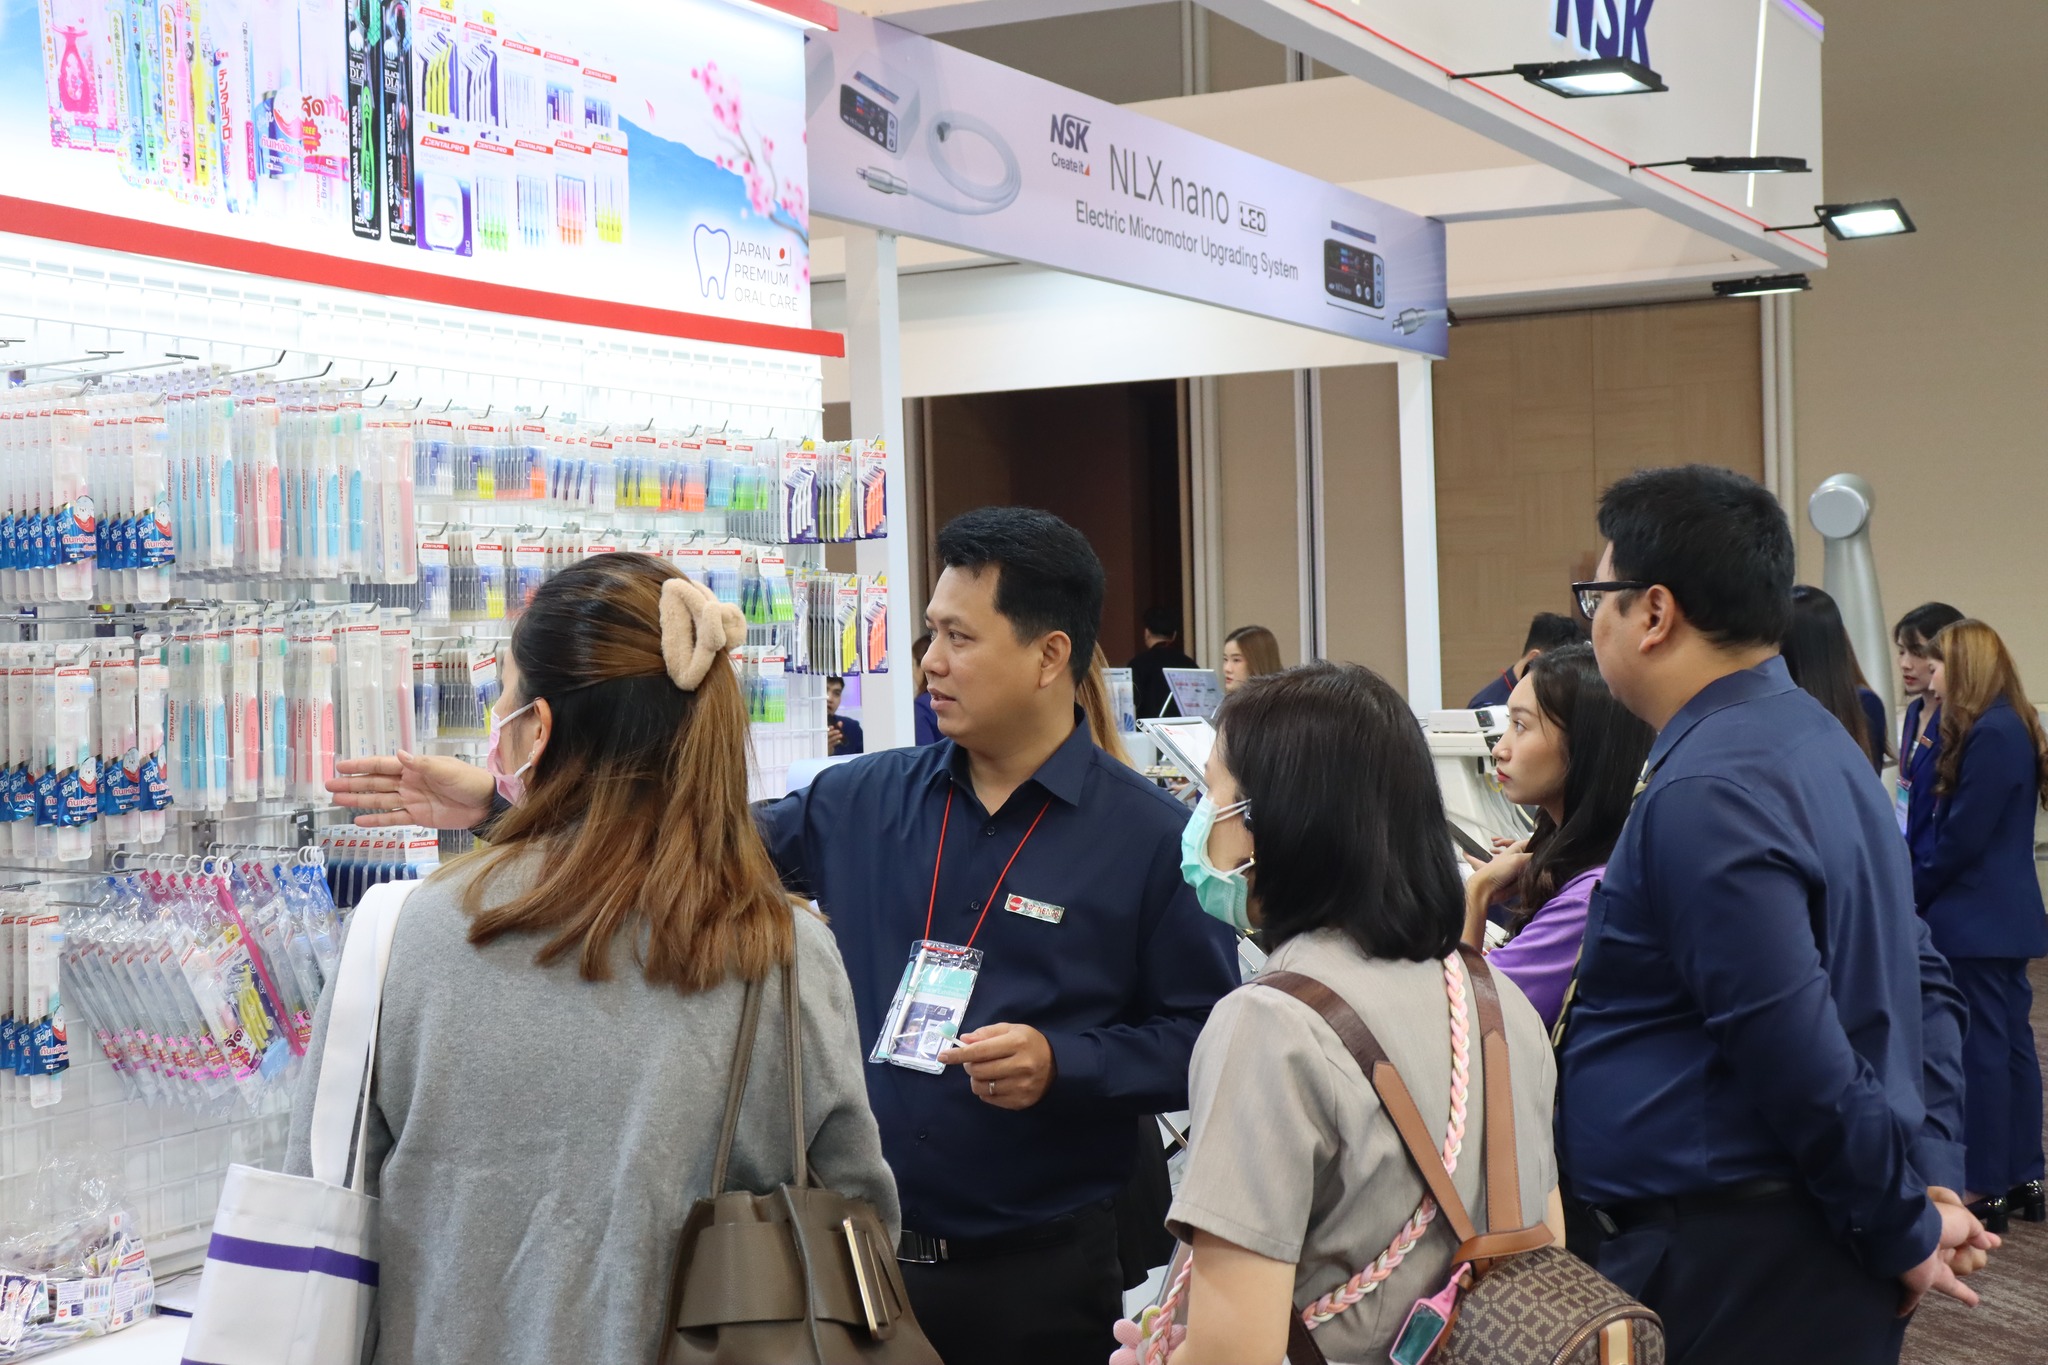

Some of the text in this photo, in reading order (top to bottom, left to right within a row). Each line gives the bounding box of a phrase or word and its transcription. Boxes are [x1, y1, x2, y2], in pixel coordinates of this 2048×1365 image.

[1556, 0, 1654, 70] NSK
[218, 68, 232, 140] デンタルプロ
[1050, 114, 1091, 154] NSK
[425, 138, 465, 152] DENTALPRO
[477, 142, 508, 153] DENTALPRO
[1052, 152, 1078, 174] Create
[1110, 144, 1266, 232] NLX nano LED
[734, 240, 770, 260] JAPAN
[1076, 199, 1298, 280] Electric Micromotor Upgrading System
[734, 264, 788, 286] PREMIUM
[734, 287, 798, 312] ORAL CARE
[57, 518, 74, 533] Soft
[138, 523, 155, 538] Soft
[61, 780, 79, 796] Soft
[106, 769, 124, 786] Soft
[34, 1028, 52, 1046] Soft
